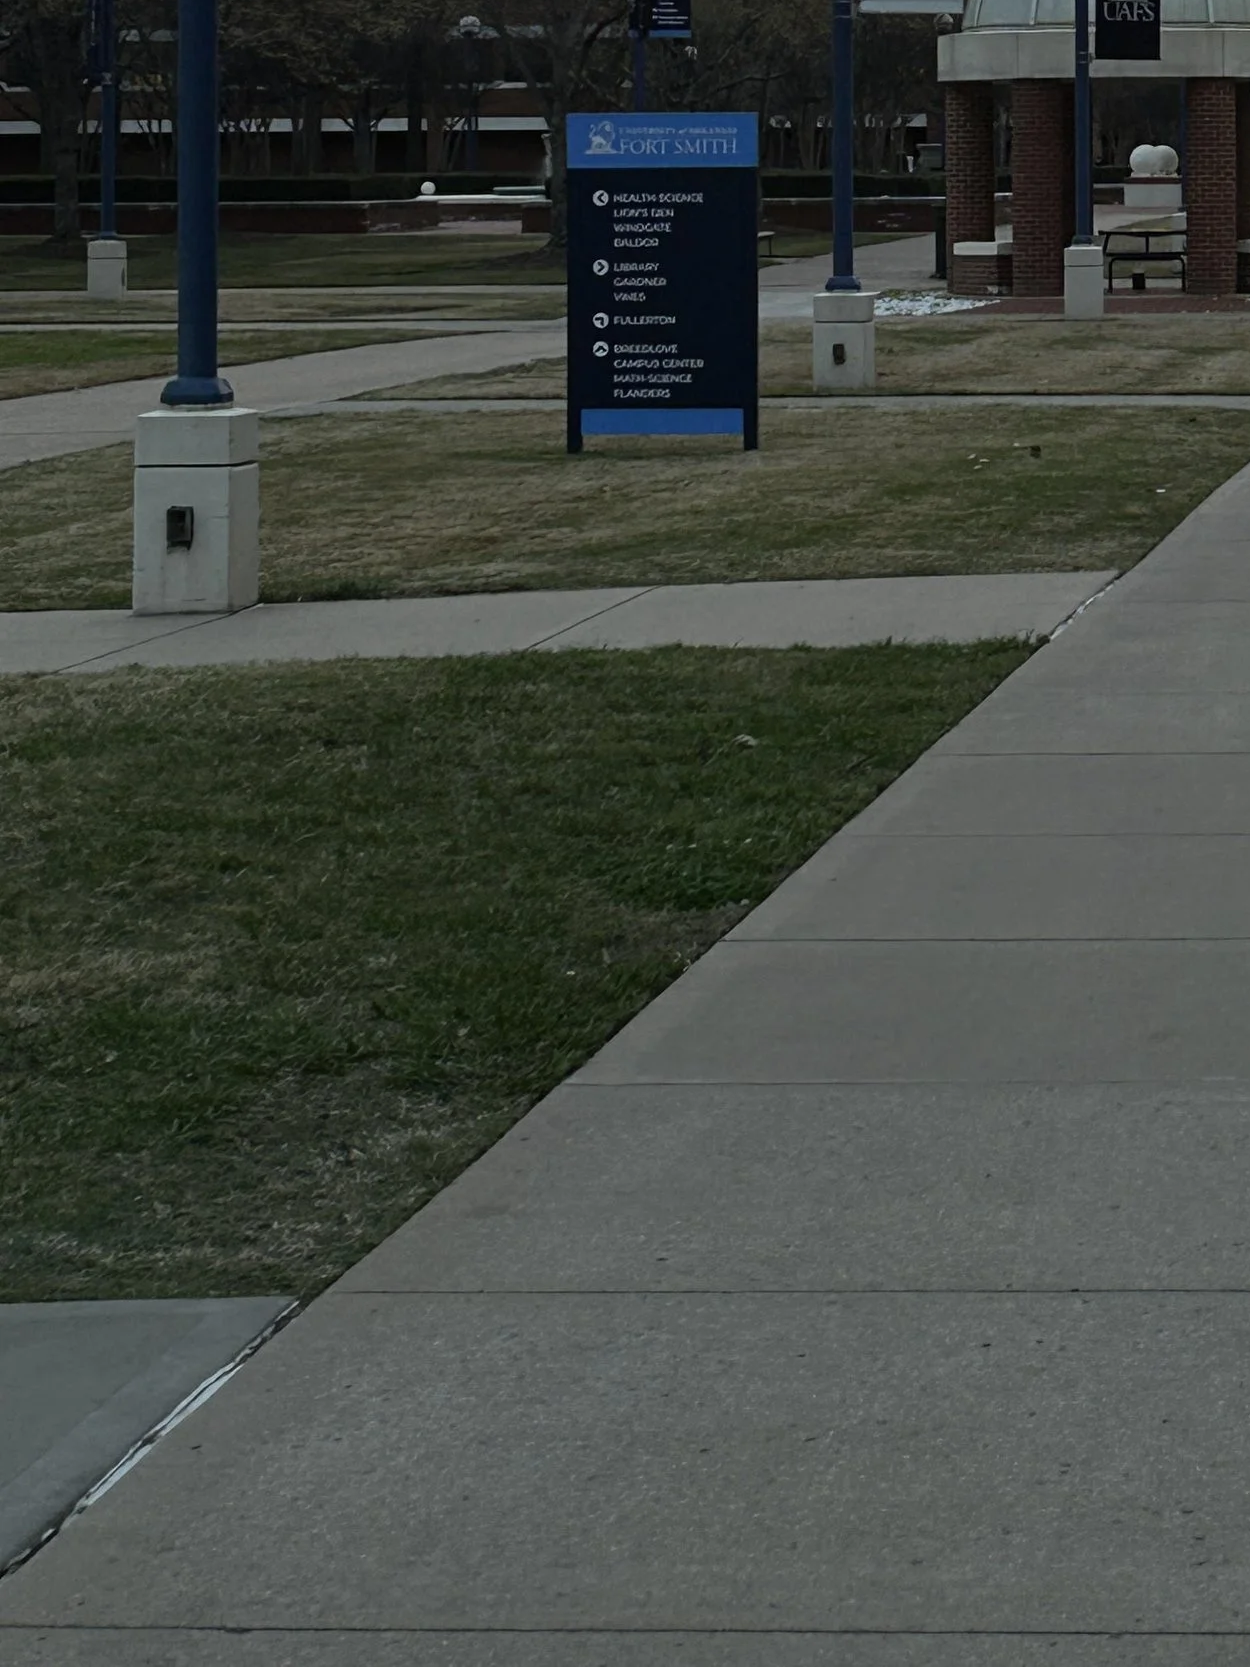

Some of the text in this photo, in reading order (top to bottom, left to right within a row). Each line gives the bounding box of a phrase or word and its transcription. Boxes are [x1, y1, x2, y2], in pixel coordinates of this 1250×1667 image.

[1103, 1, 1155, 21] UAFS
[619, 137, 737, 155] FORT SMITH
[658, 193, 704, 203] SCIENCE
